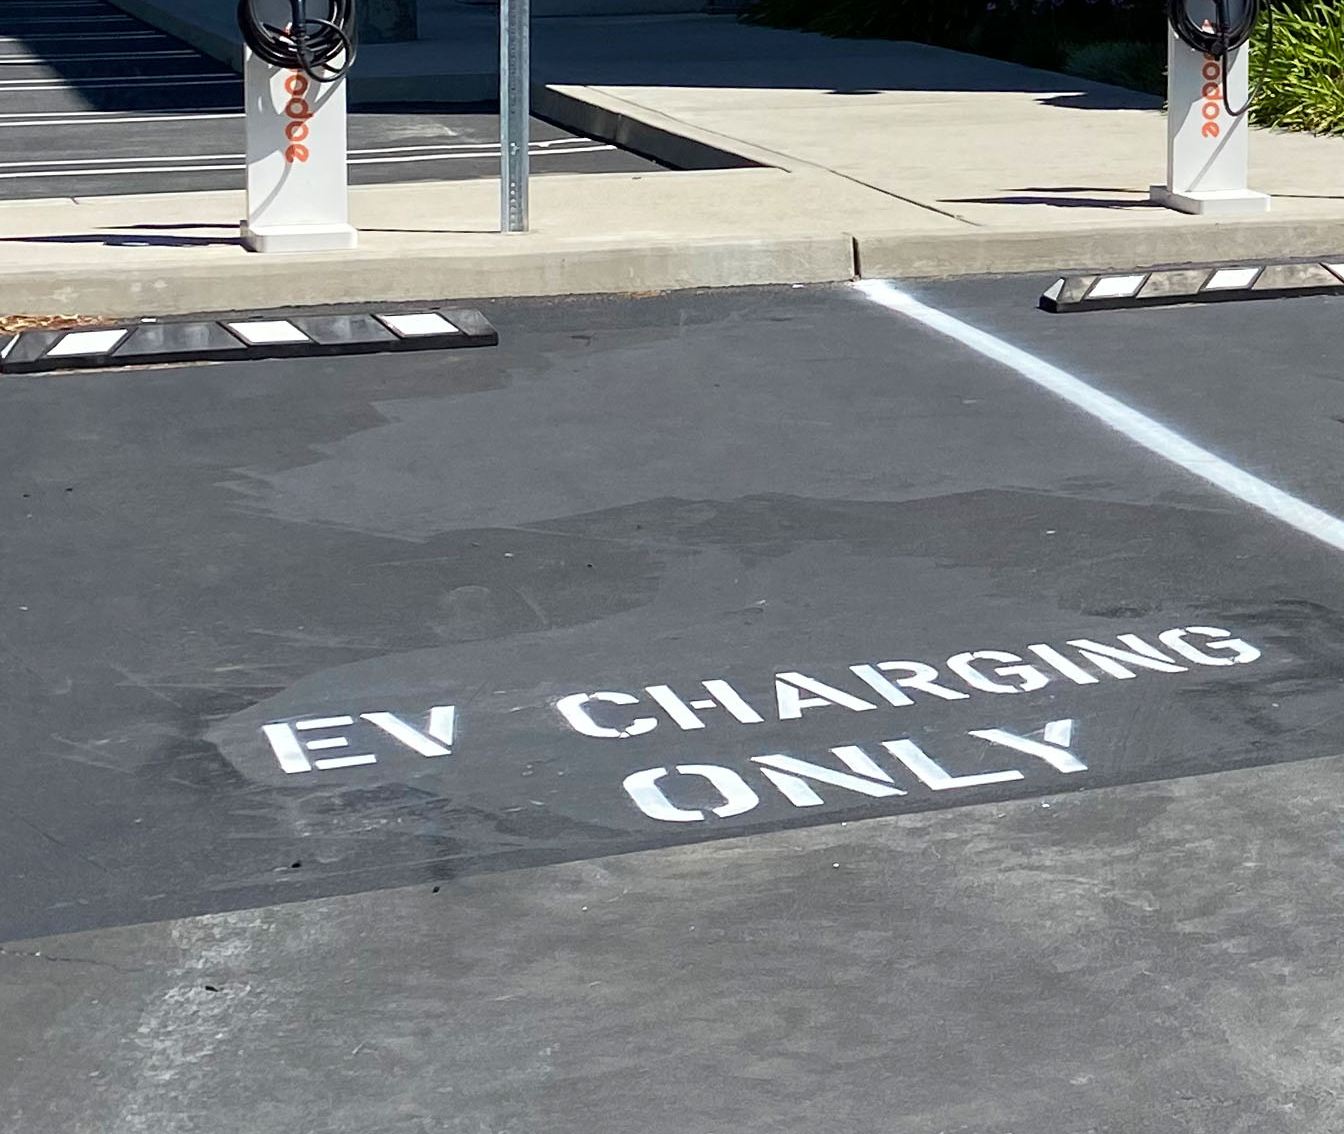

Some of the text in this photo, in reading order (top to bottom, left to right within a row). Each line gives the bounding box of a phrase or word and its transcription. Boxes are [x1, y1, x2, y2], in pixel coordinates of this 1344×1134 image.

[260, 626, 1262, 774] EV CHARGING
[623, 718, 1089, 822] ONLY
